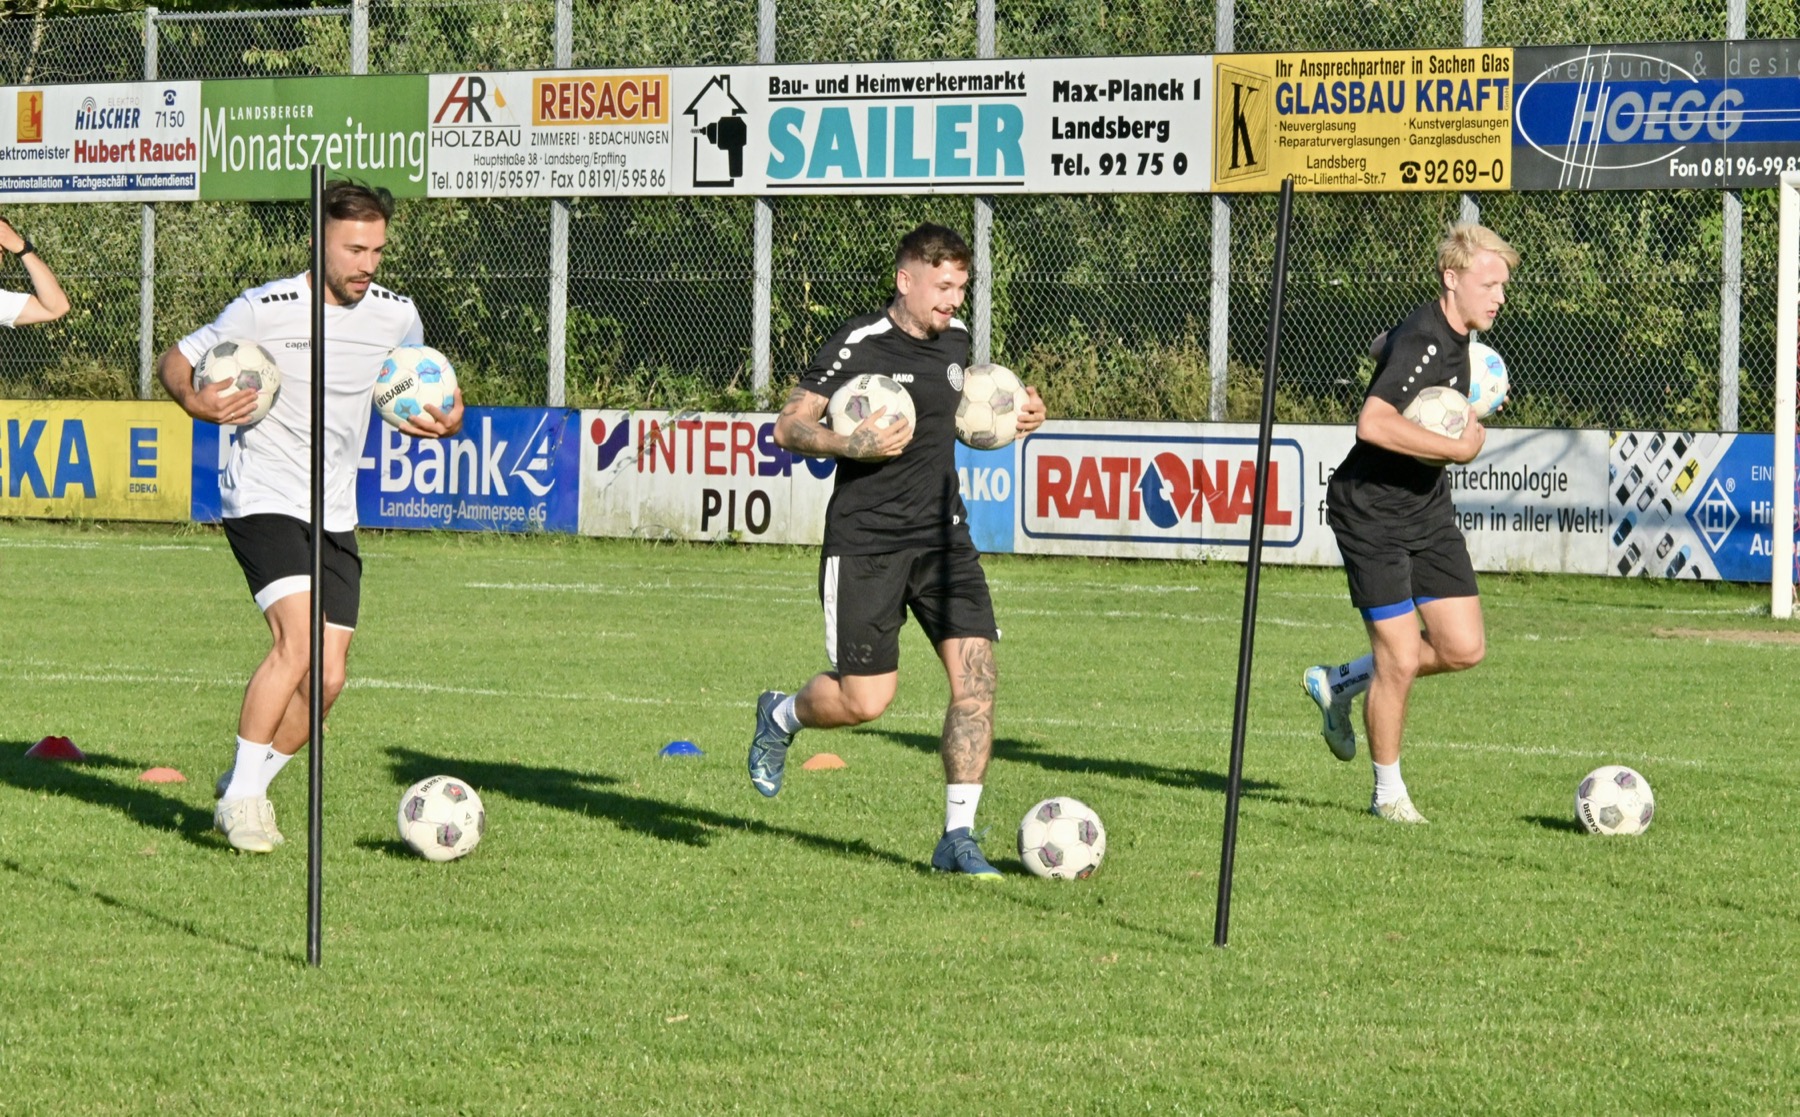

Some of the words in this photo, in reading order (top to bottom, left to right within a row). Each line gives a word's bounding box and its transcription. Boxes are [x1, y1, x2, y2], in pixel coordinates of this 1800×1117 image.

[1276, 60, 1293, 78] Ihr
[1300, 57, 1405, 80] Ansprechpartner
[1411, 56, 1423, 75] in
[1429, 55, 1475, 74] Sachen
[1482, 53, 1509, 73] Glas
[1545, 52, 1671, 84] werbung
[1692, 51, 1707, 76] &
[1729, 48, 1800, 79] desi
[769, 75, 809, 95] Bau-
[816, 74, 849, 94] und
[856, 71, 1026, 93] Heimwerkermarkt
[1053, 78, 1184, 103] Max-Planck
[108, 97, 140, 107] ELEKTRO
[540, 80, 662, 121] REISACH
[1275, 81, 1405, 115] GLASBAU
[1416, 77, 1510, 112] KRAFT
[230, 105, 314, 120] LANDSBERGER
[1409, 117, 1509, 131] Kunstverglasungen
[1570, 88, 1744, 142] HOEGG
[531, 132, 580, 146] ZIMMEREI
[589, 130, 669, 145] BEDACHUNGEN
[1052, 115, 1170, 143] Landsberg
[1229, 82, 1259, 170] K
[1279, 120, 1357, 133] Neuverglasung
[74, 139, 136, 163] Hubert
[140, 137, 196, 162] Rauch
[201, 107, 426, 183] Monatszeitung
[432, 130, 521, 148] HOLZBAU
[766, 103, 1025, 180] SAILER
[1279, 135, 1400, 149] Reparaturverglasungen
[1409, 133, 1501, 147] Ganzglasduschen
[0, 145, 70, 160] ektromeister
[473, 153, 526, 168] Hauptstraße
[527, 153, 538, 165] 38
[1051, 153, 1090, 176] Tel.
[1099, 152, 1127, 176] 92
[1137, 152, 1165, 176] 75
[1173, 152, 1188, 176] 0
[1306, 155, 1367, 171] Landsberg
[551, 170, 574, 188] Fax
[1669, 158, 1698, 177] Fon
[72, 176, 128, 190] Fachgeschäft
[136, 174, 194, 188] Kundendienst
[432, 172, 453, 189] Tel.
[376, 377, 415, 408] DERBYSTAR
[0, 418, 97, 498] KA
[130, 427, 157, 479] E
[129, 483, 158, 493] EDEKA
[1037, 452, 1292, 529] RATIONAL
[380, 497, 525, 525] Landsberg-Ammersee
[528, 502, 547, 522] eG
[700, 488, 771, 535] PIO
[1490, 505, 1507, 532] in
[1513, 505, 1552, 532] aller
[1558, 505, 1604, 533] Welt!
